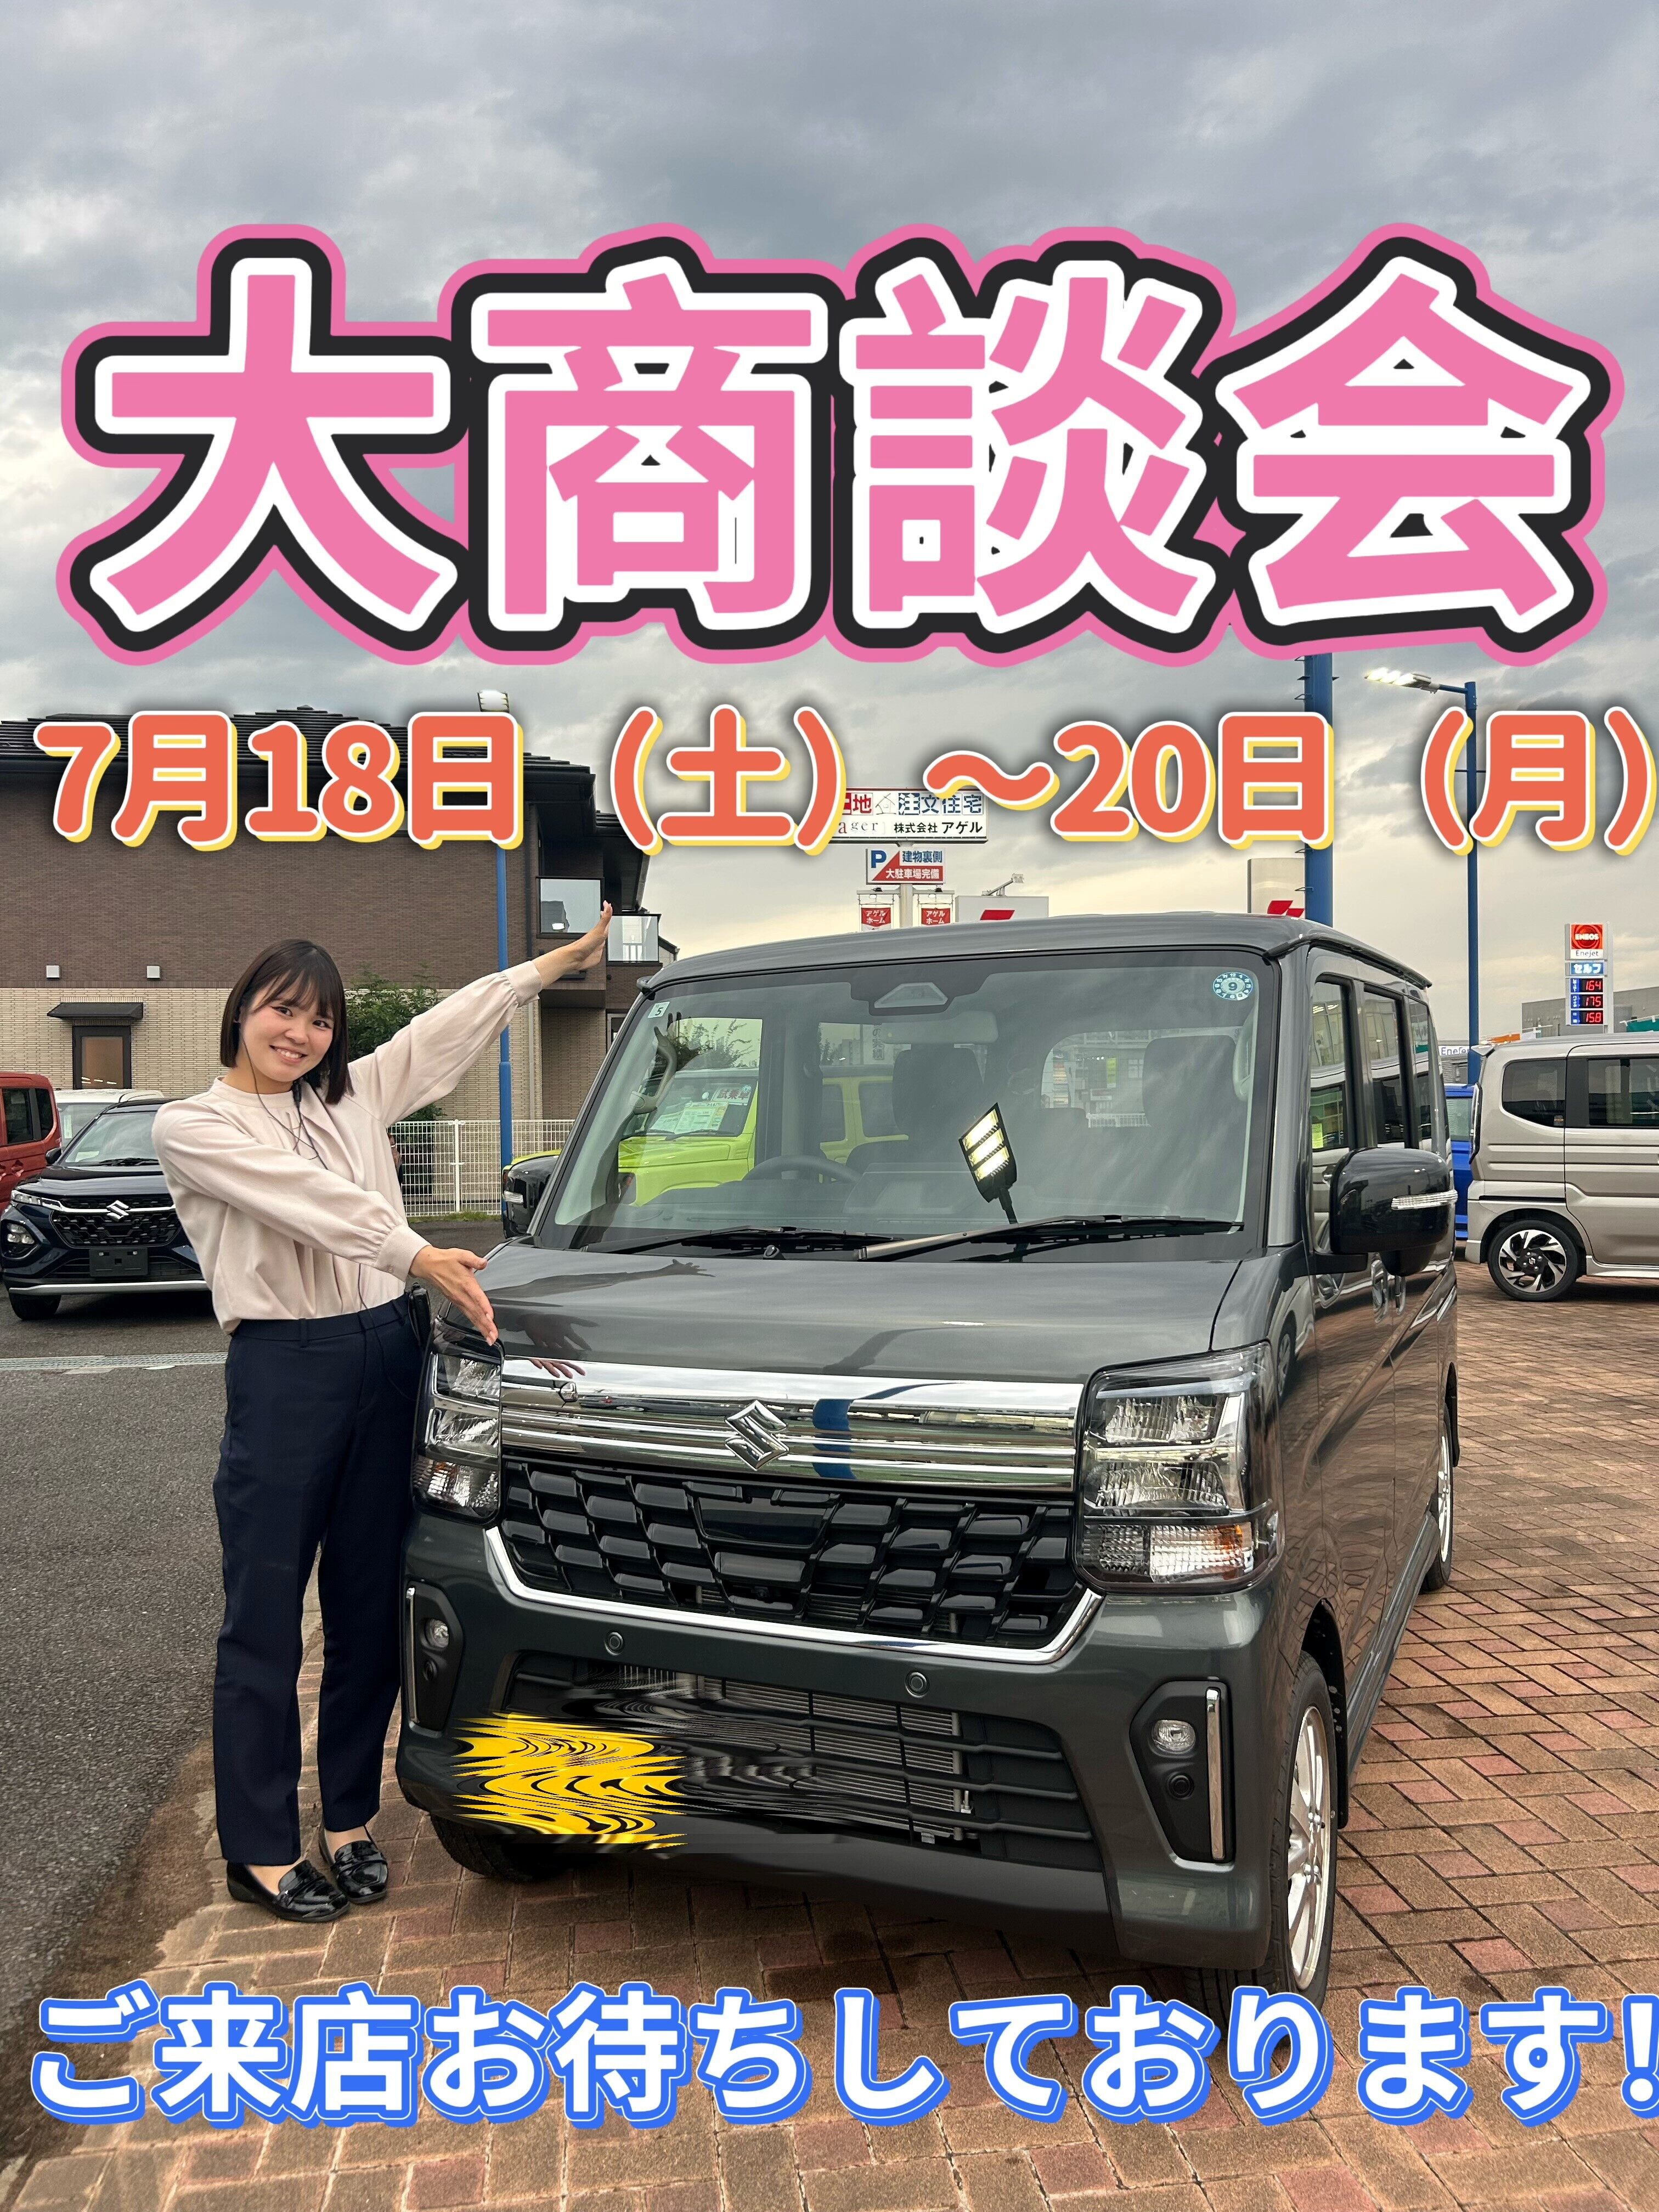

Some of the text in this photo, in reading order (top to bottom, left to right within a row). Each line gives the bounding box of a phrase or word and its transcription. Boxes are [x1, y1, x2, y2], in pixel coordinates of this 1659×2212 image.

[894, 821, 983, 834] 株式会社 アゲル
[871, 850, 887, 868] P
[902, 850, 943, 863] 建物裏側
[885, 868, 940, 879] 大駐車場完備
[1573, 963, 1601, 973] セルフ
[1228, 982, 1238, 991] 9
[1585, 980, 1601, 991] 164
[1585, 996, 1601, 1007] 175
[655, 1007, 664, 1015] 5
[1585, 1012, 1601, 1023] 158
